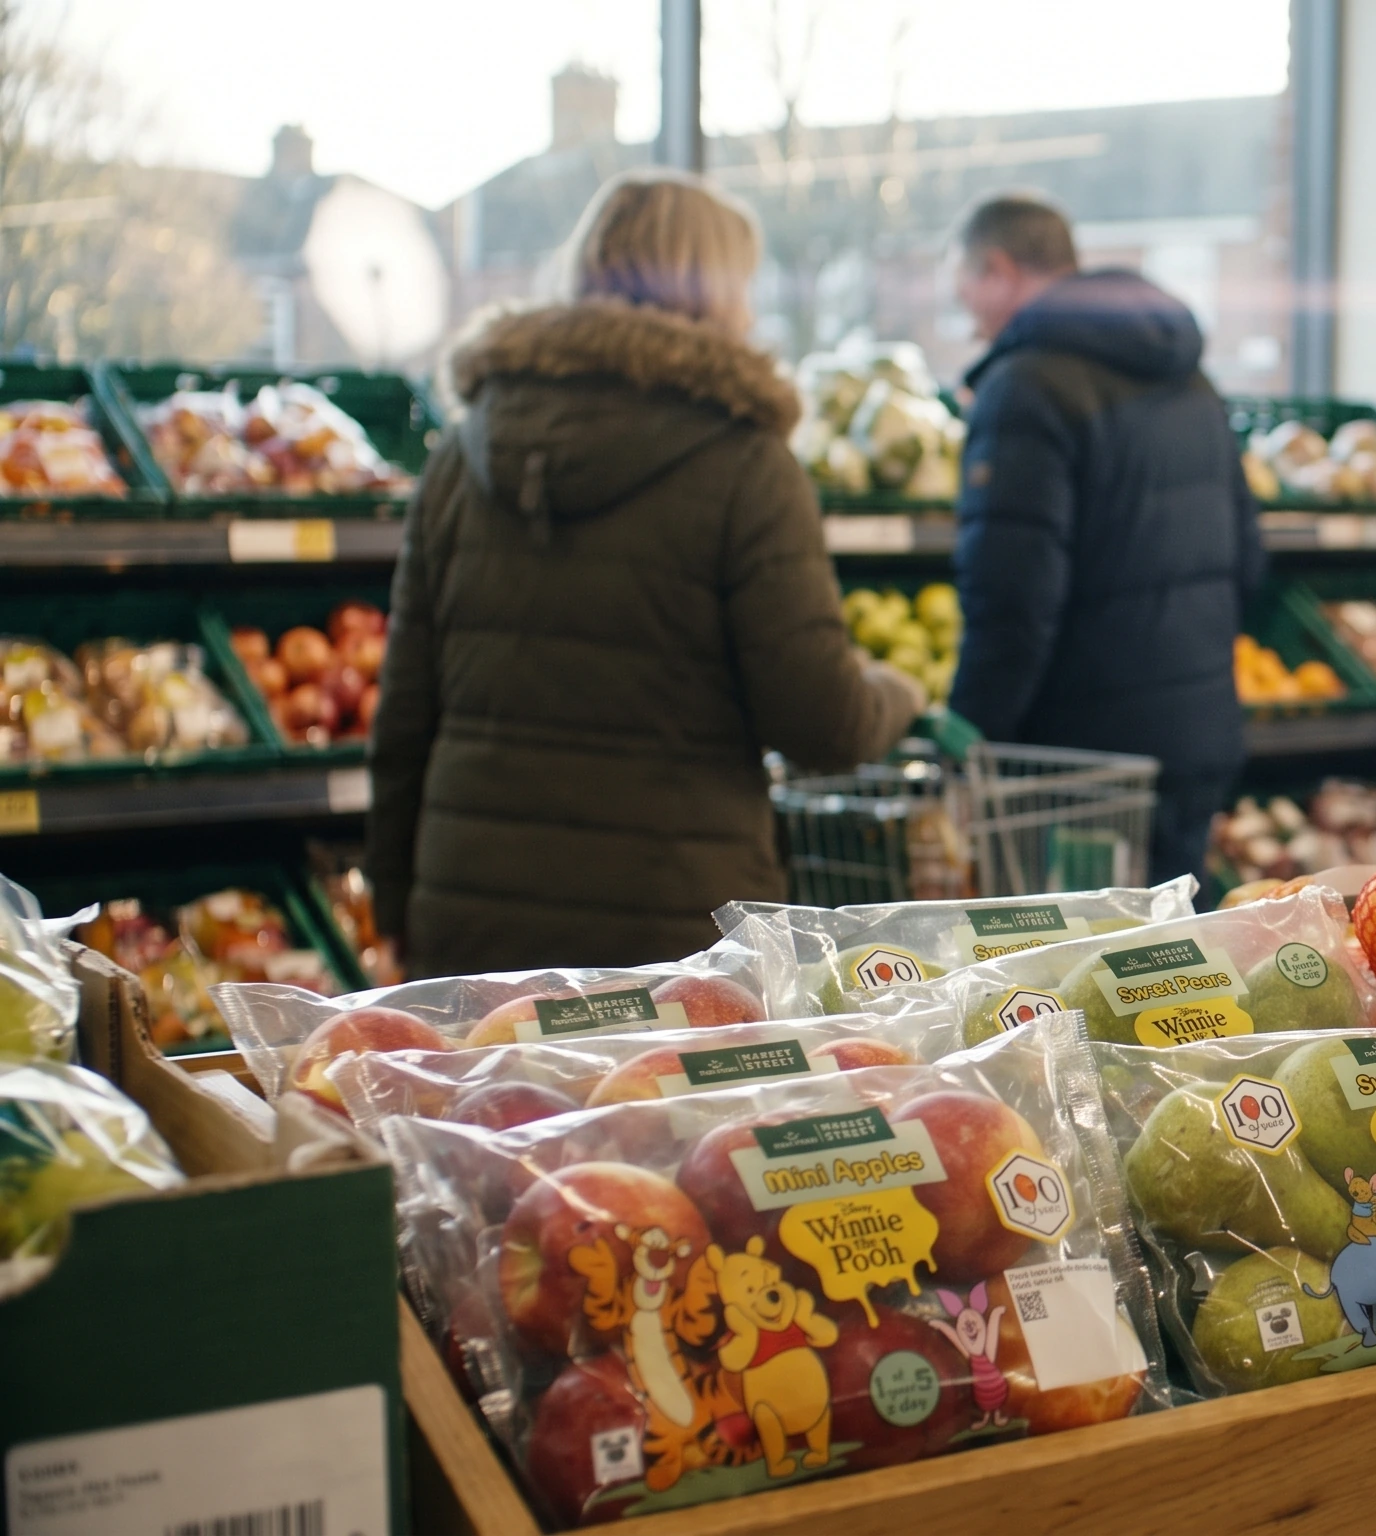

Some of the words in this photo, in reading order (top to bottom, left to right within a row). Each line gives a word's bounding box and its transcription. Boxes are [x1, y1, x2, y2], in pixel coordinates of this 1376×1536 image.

[1173, 972, 1232, 993] Pears
[1152, 1010, 1227, 1039] Winnie
[763, 1164, 828, 1195] Mini
[833, 1150, 924, 1186] Apples
[801, 1208, 904, 1244] Winnie
[829, 1237, 906, 1275] Pooh
[914, 1367, 933, 1391] 5
